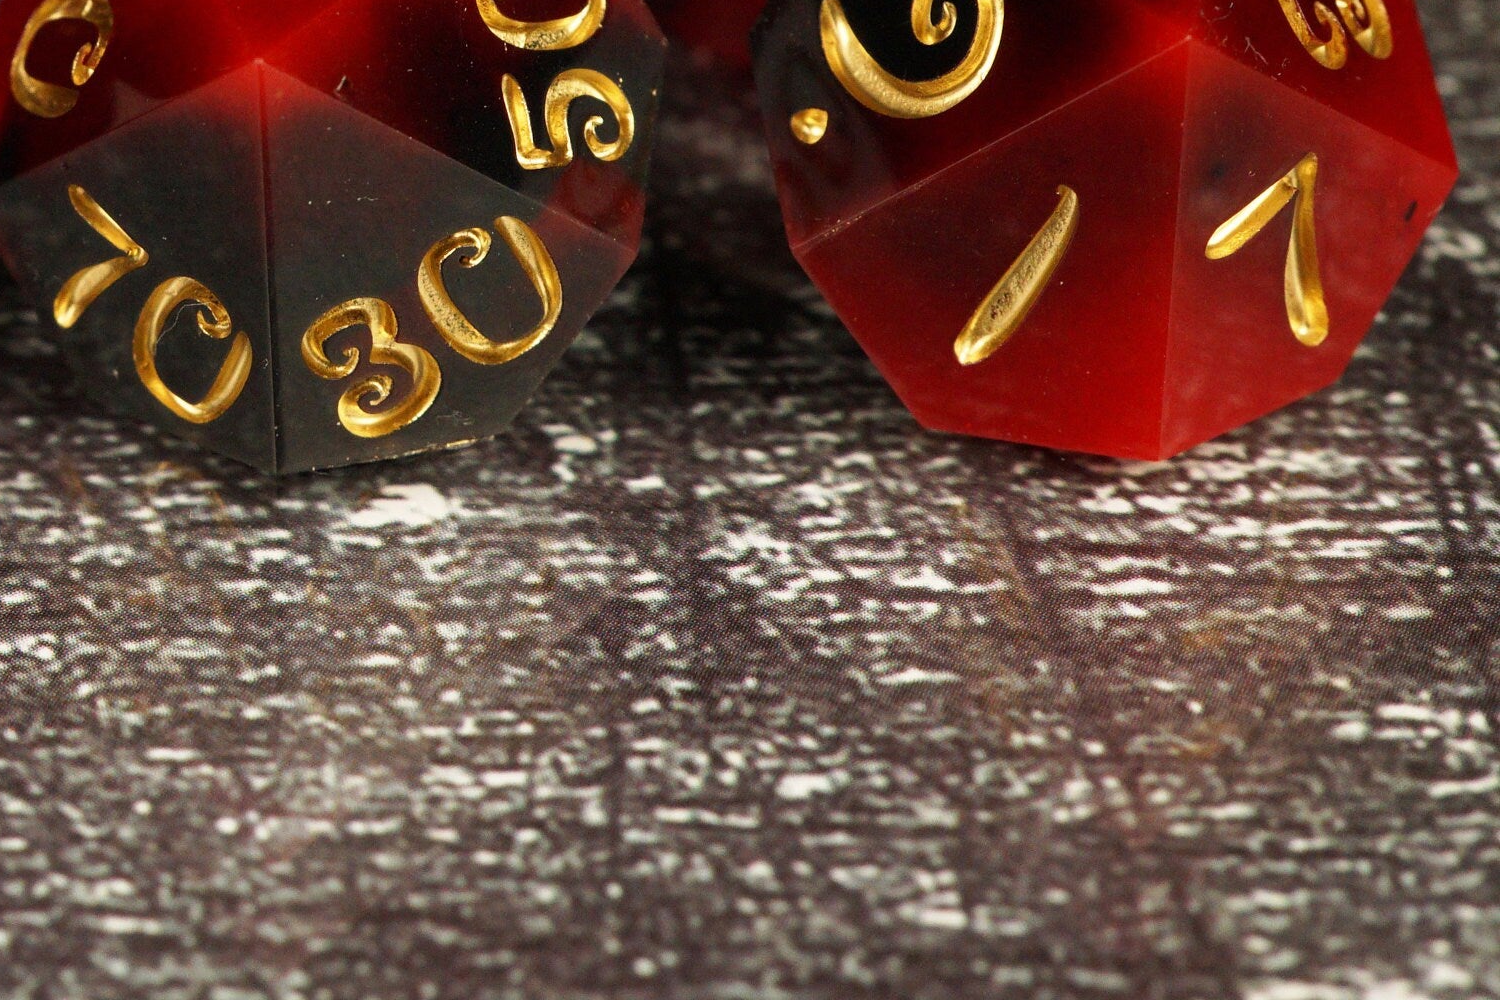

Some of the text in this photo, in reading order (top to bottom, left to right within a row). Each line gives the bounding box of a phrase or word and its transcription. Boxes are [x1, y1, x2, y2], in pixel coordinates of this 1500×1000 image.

[53, 184, 253, 424] 70
[301, 215, 564, 437] 30
[953, 185, 1079, 366] 1
[1204, 152, 1330, 346] 7
